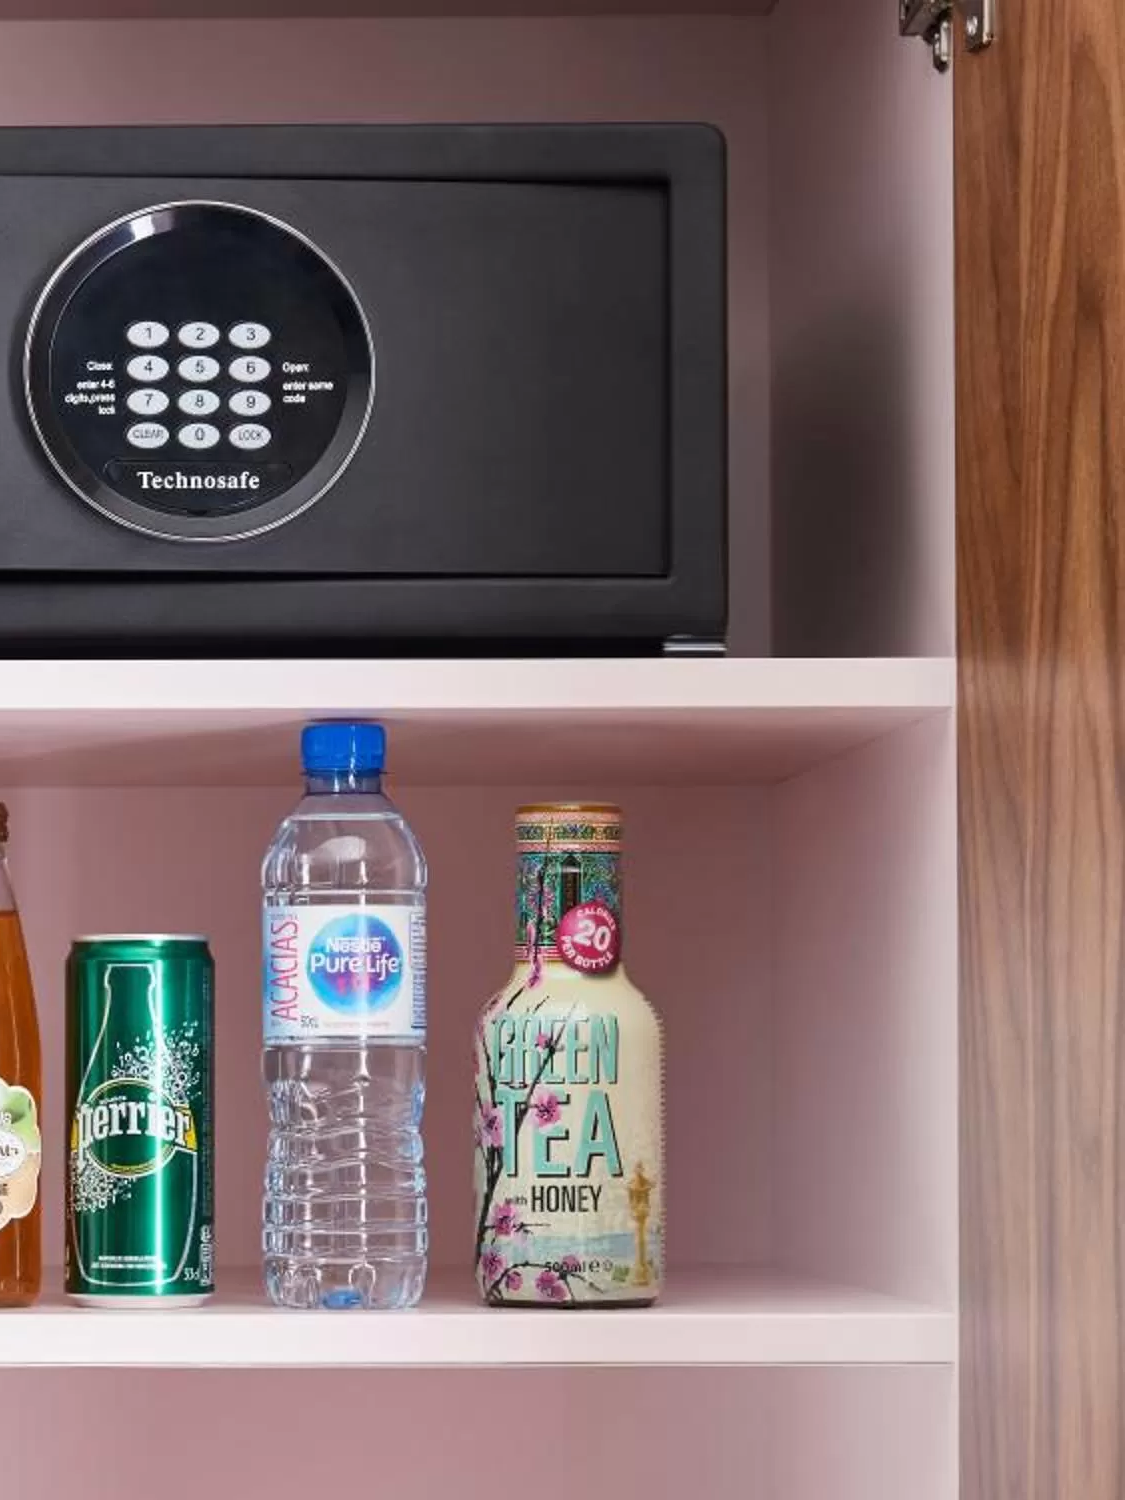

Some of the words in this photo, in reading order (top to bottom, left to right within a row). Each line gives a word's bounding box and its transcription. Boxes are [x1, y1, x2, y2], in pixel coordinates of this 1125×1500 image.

[136, 470, 261, 490] Technosafe
[573, 919, 612, 952] 20
[270, 919, 299, 1022] ACACIAS
[311, 953, 363, 973] Pure
[366, 953, 401, 981] Life
[491, 1012, 619, 1087] GREEN
[495, 1088, 624, 1178] TEA
[531, 1184, 603, 1213] HONEY
